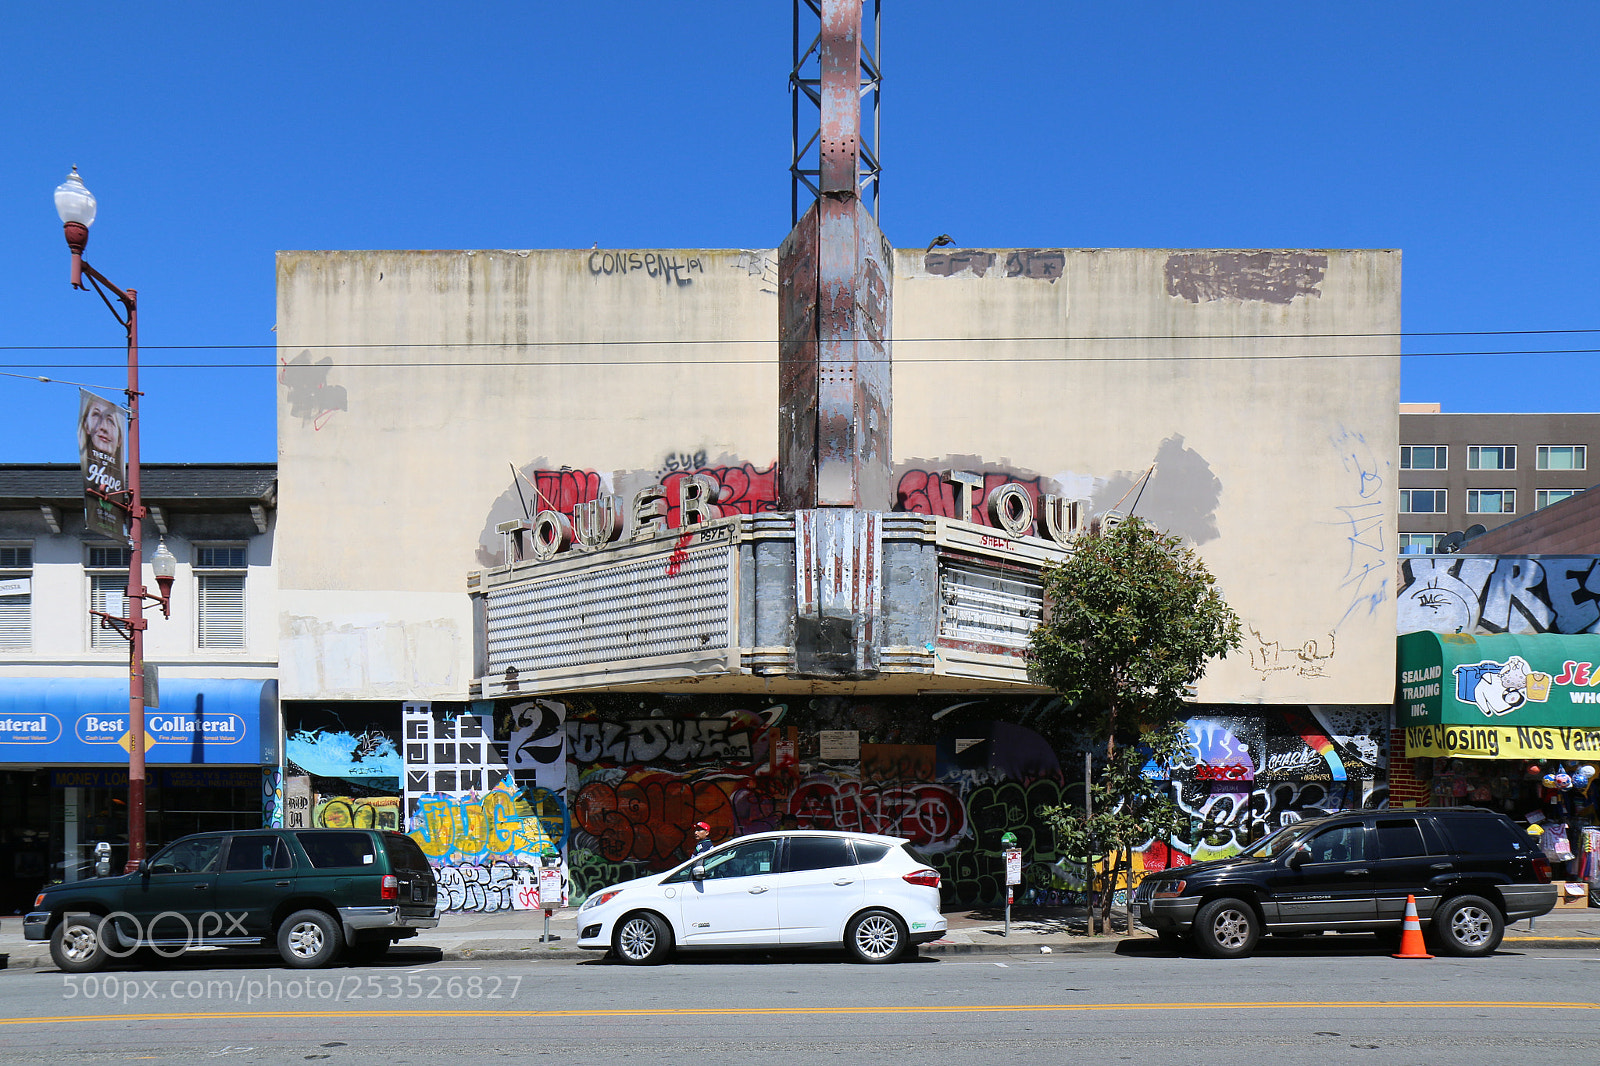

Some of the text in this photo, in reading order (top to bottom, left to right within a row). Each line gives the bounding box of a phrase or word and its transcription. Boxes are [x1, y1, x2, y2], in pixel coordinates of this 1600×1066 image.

[86, 463, 122, 493] Hope
[495, 474, 720, 562] TOWER
[1402, 665, 1442, 684] SEALAND
[1402, 683, 1440, 700] TRADING
[1411, 703, 1428, 717] INC.
[86, 716, 235, 732] Best Collateral
[1434, 724, 1499, 756] Closing
[1517, 725, 1553, 750] Nos
[55, 772, 153, 785] MONEY LOAD
